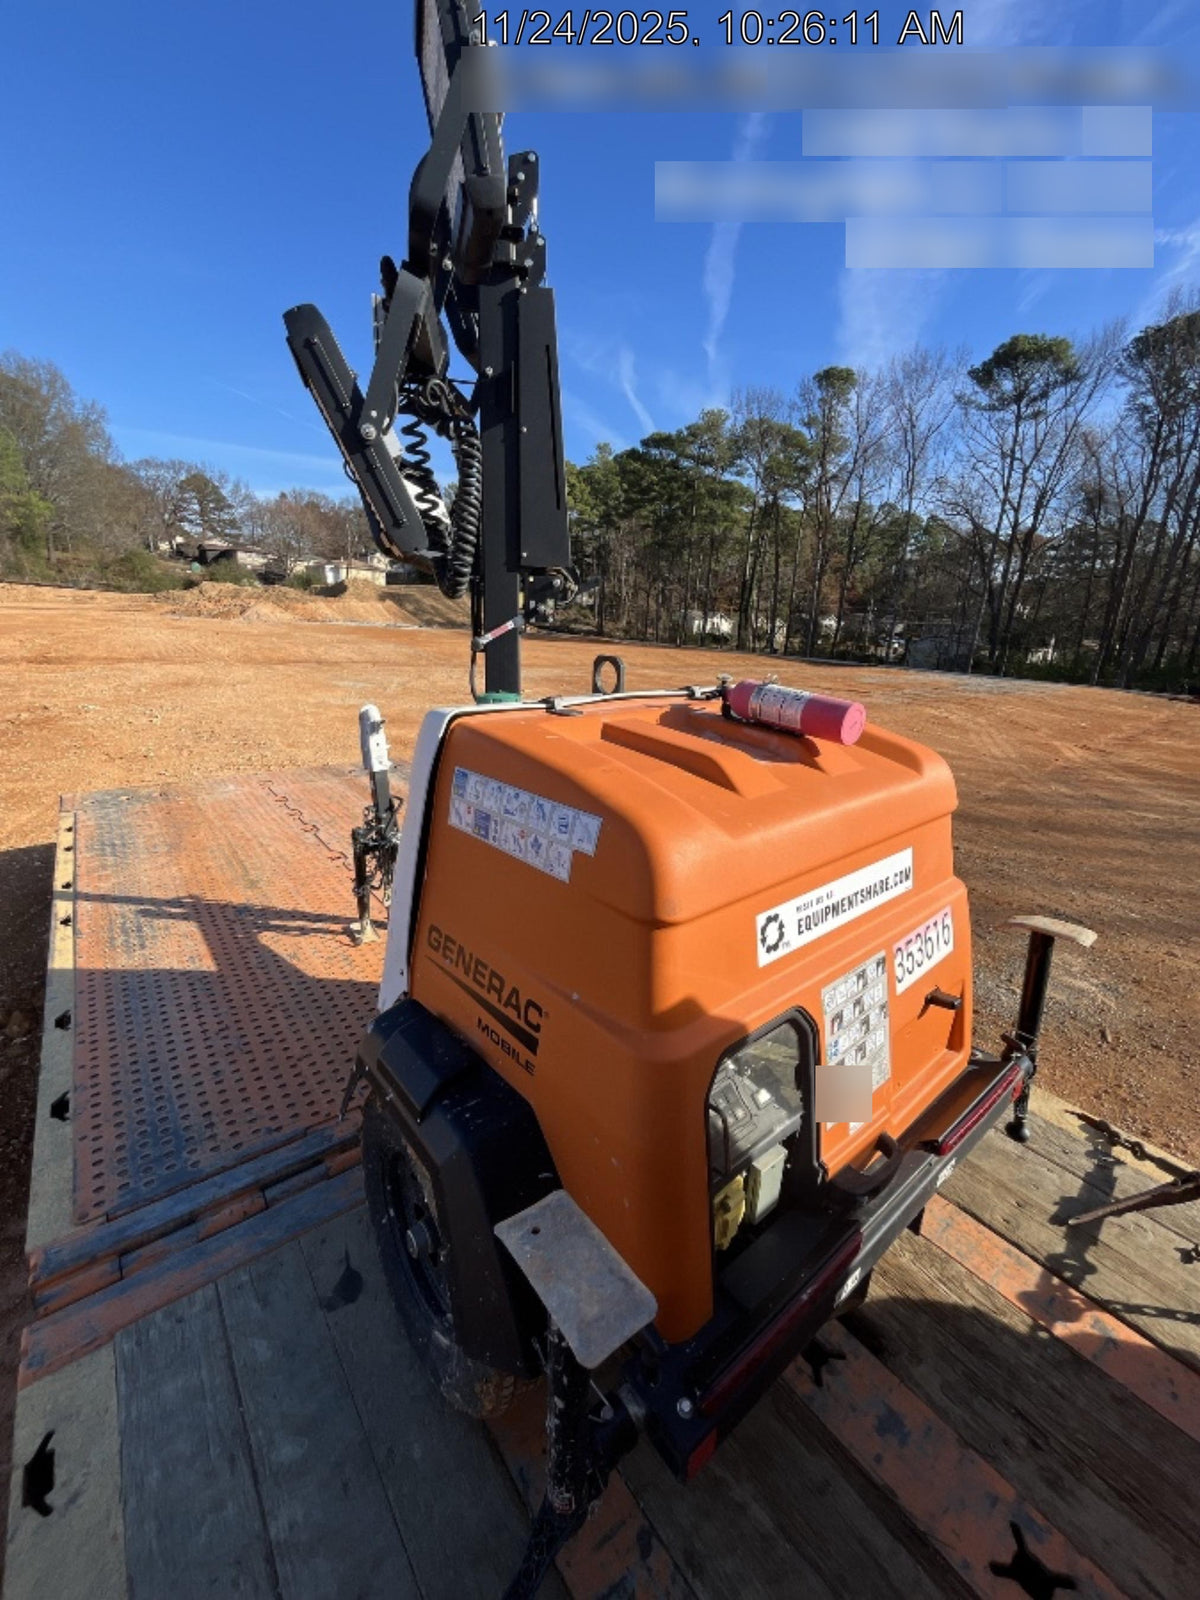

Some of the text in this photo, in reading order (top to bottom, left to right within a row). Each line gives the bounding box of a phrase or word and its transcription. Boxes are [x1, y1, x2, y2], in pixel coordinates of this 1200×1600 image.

[797, 865, 911, 937] EQUIPMENTSHARE.COM
[427, 924, 544, 1034] GENERAC
[896, 911, 951, 984] 353616
[477, 1016, 537, 1077] MOBILE
